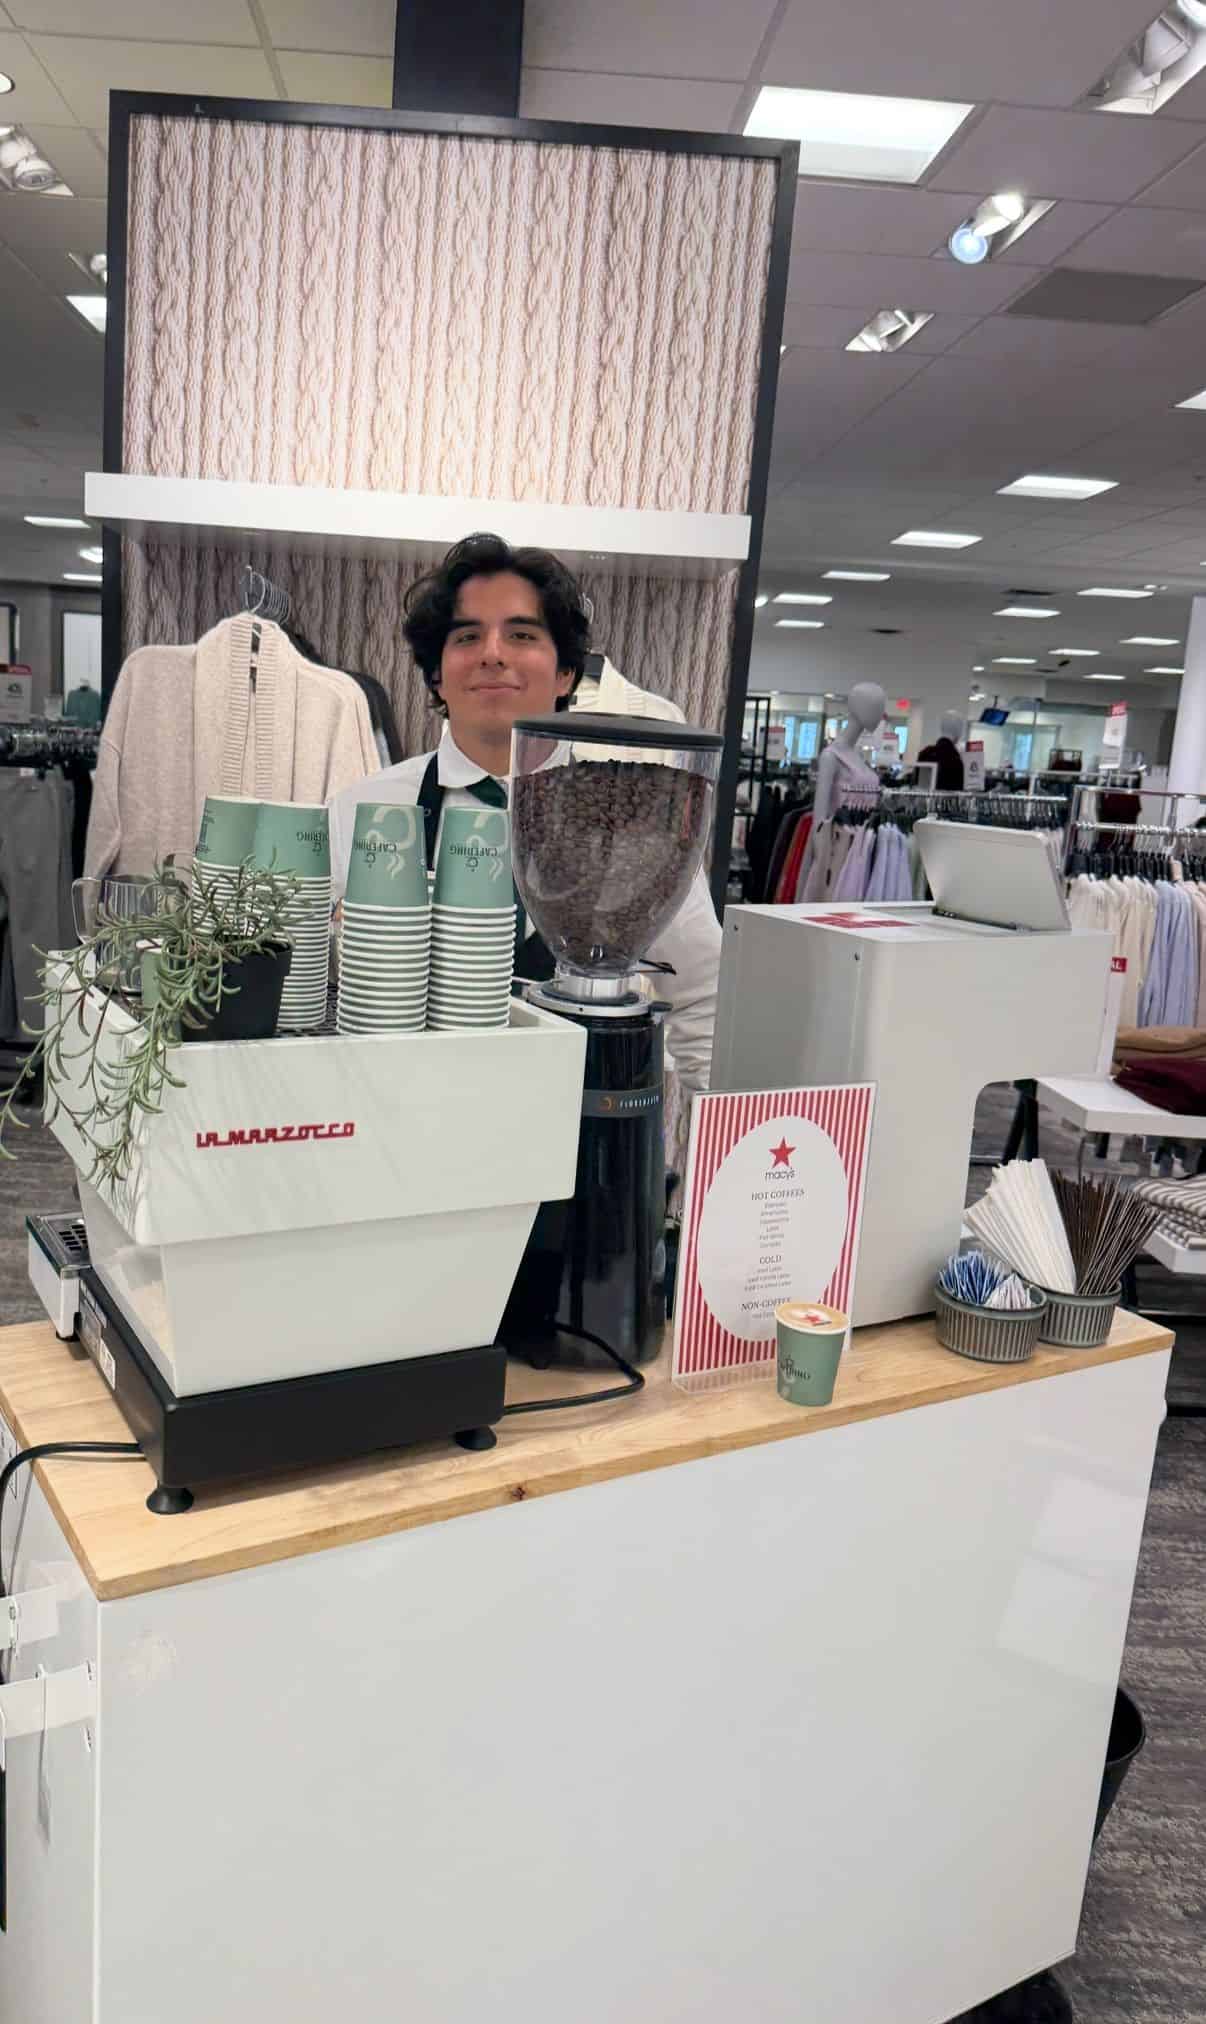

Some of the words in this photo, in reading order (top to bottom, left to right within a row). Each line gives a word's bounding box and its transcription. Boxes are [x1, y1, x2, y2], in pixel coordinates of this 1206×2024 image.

[196, 1132, 219, 1148] LA
[229, 1122, 355, 1145] MARZOCCO
[764, 1167, 795, 1180] macy's
[751, 1192, 769, 1201] HOT
[759, 1255, 782, 1265] COLD
